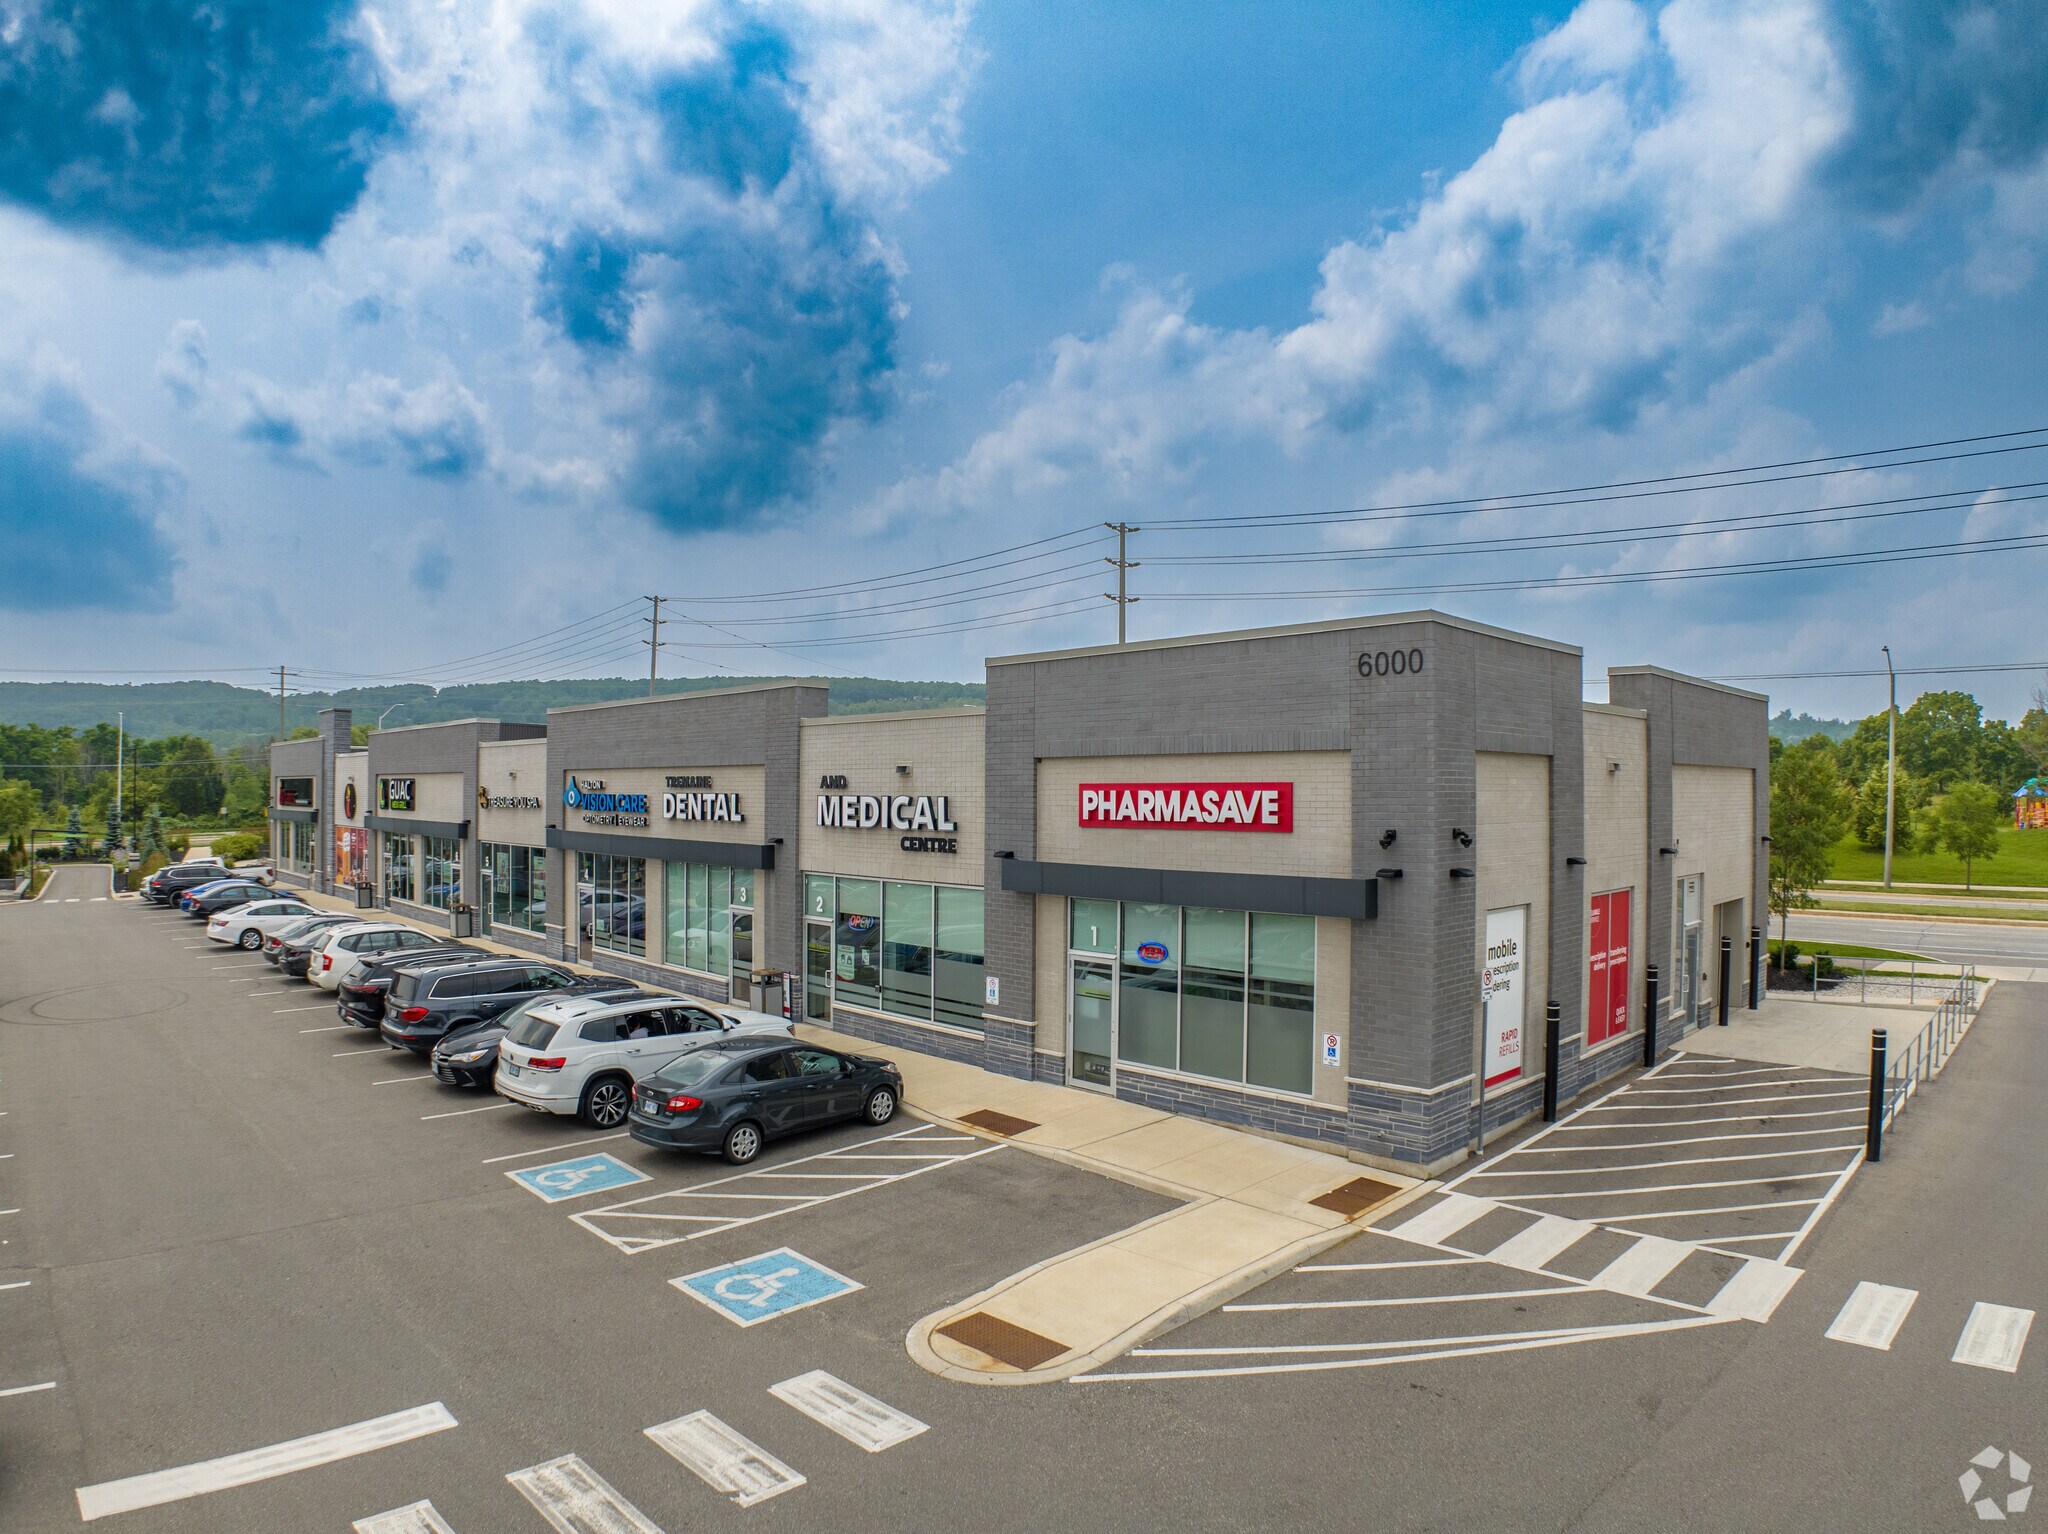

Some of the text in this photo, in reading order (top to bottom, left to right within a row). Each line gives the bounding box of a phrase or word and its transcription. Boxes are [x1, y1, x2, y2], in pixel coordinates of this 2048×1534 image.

[1358, 648, 1423, 677] 6000
[390, 780, 410, 800] GUAC
[581, 780, 601, 789] HALTON
[665, 776, 712, 788] TREMAINE
[820, 775, 847, 789] AND
[488, 796, 515, 808] TREASURE
[527, 796, 540, 809] SPA
[581, 793, 646, 813] VISION CARE
[663, 793, 743, 821] DENTAL
[1082, 790, 1279, 824] PHARMASAVE
[583, 814, 646, 827] OPTOMETRY EYEWEAR
[817, 795, 957, 831] MEDICAL
[901, 837, 957, 854] CENTRE
[485, 856, 490, 867] 5
[740, 887, 747, 903] 3
[816, 896, 823, 912] 2
[849, 915, 871, 929] OPEN
[1090, 926, 1097, 946] 1
[1488, 938, 1517, 961] mobile
[1493, 960, 1519, 976] escription
[1493, 978, 1511, 992] dering
[1501, 1028, 1518, 1043] RAPID
[1499, 1041, 1519, 1057] REFILLS
